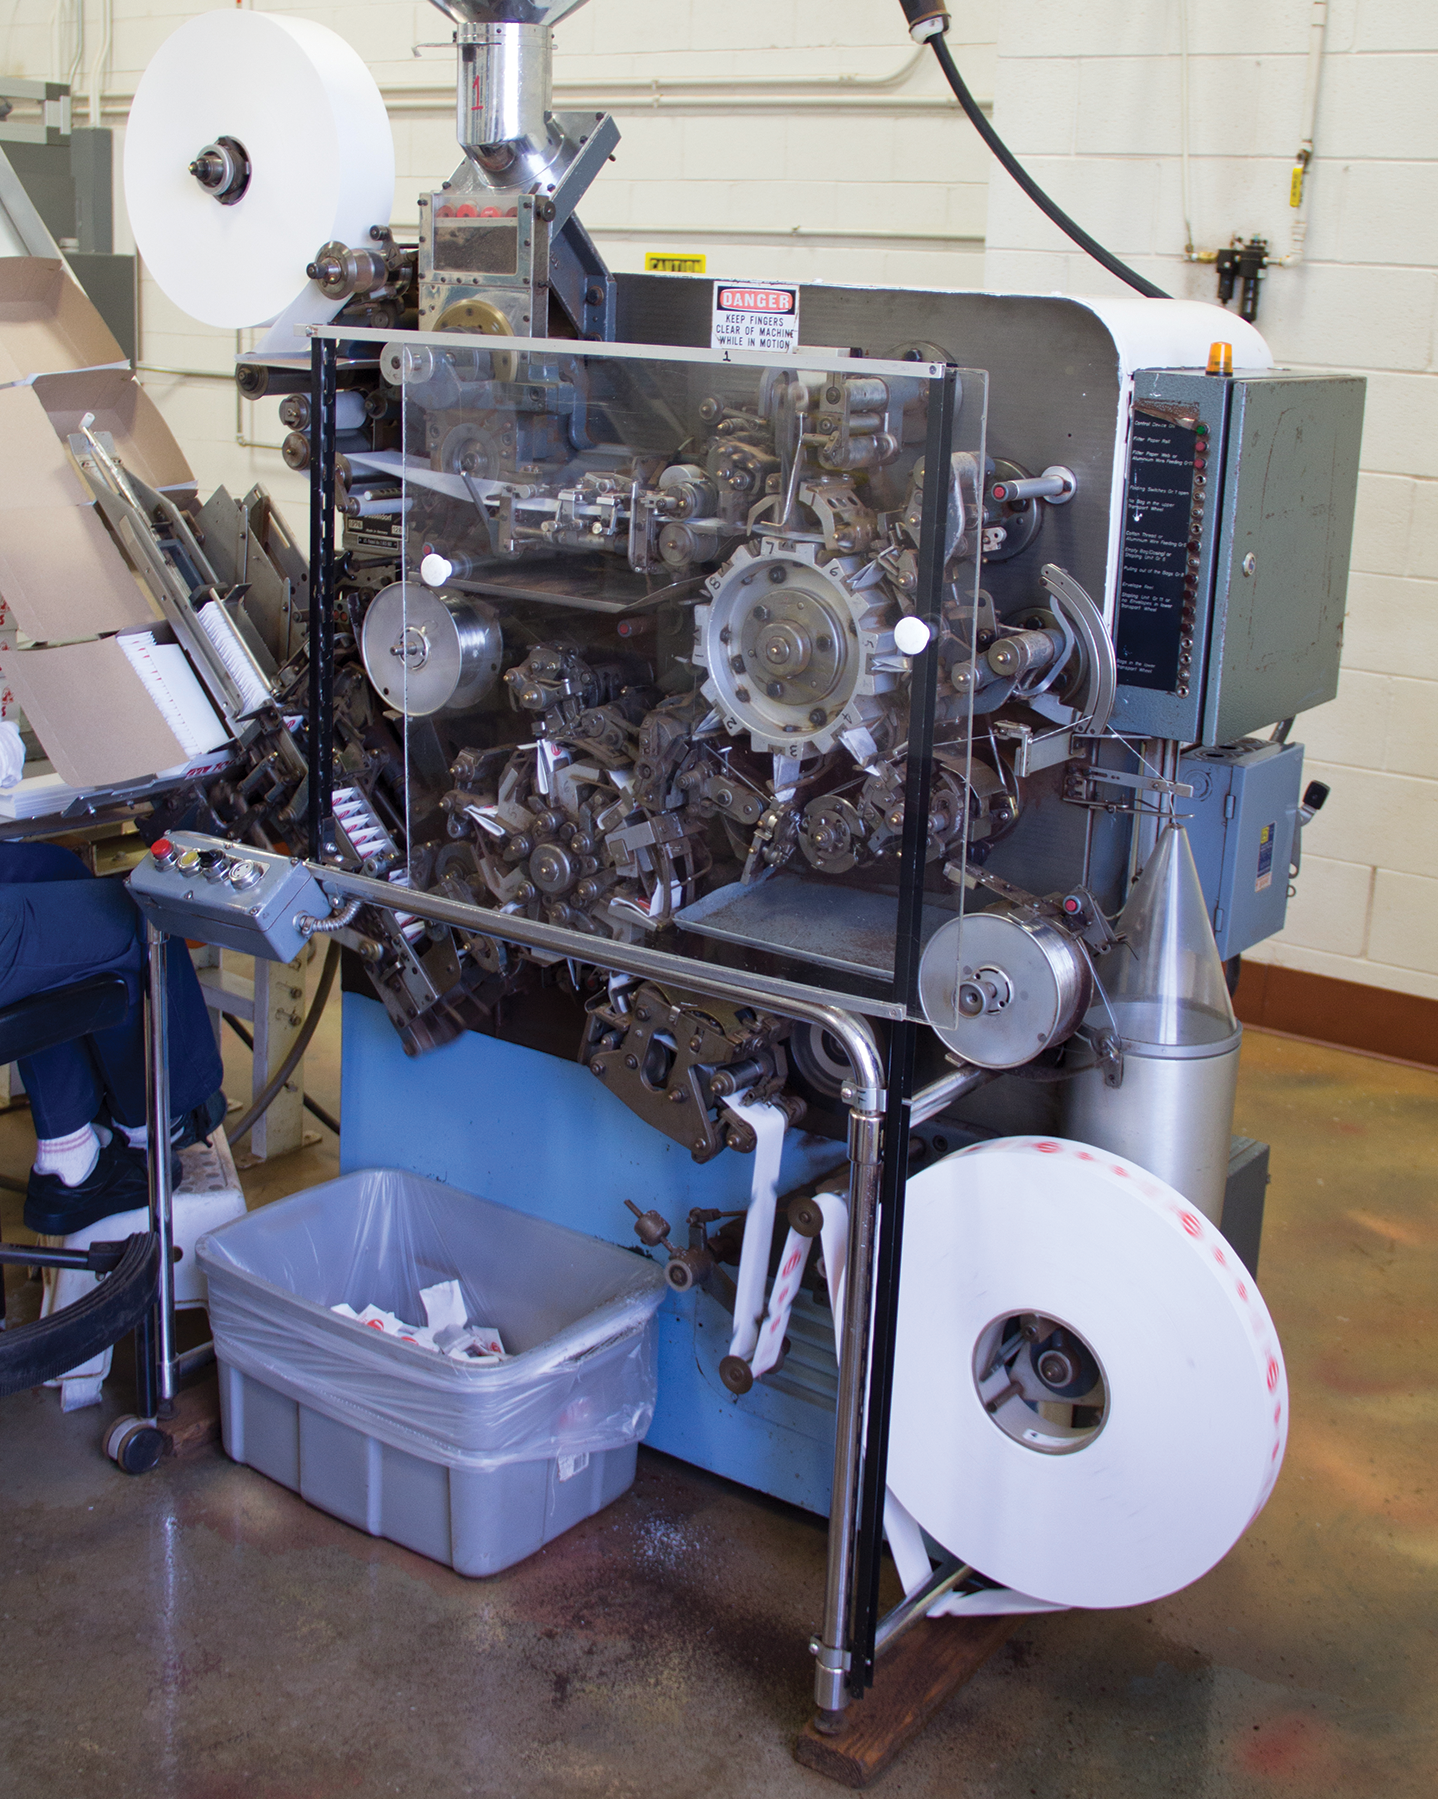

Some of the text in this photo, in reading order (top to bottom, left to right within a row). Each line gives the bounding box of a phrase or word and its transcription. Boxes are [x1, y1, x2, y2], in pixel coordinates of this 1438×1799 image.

[471, 75, 484, 110] 1
[723, 292, 789, 308] DANGER
[726, 314, 784, 326] KEEP FINGERS
[716, 325, 794, 338] CLEAR OF MACHINE
[720, 336, 790, 349] WHILE IN MOTION
[722, 350, 731, 362] 1
[766, 542, 774, 554] 7
[709, 577, 720, 590] 8
